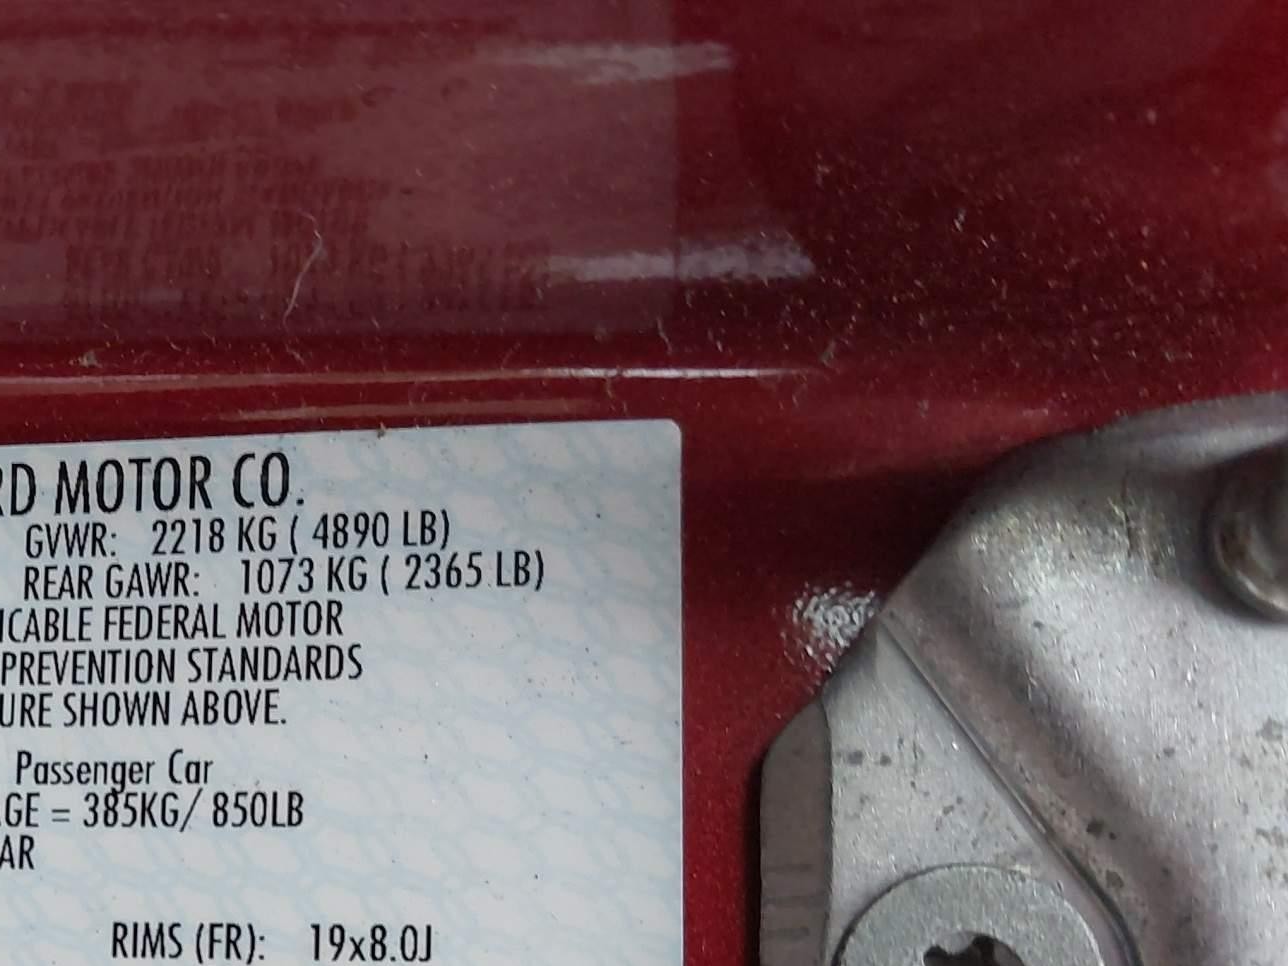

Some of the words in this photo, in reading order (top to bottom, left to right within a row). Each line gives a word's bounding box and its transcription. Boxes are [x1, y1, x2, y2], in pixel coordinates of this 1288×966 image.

[55, 455, 212, 515] MOTOR
[232, 451, 304, 509] CO.
[26, 522, 116, 559] GVWR:
[152, 518, 224, 555] 2218
[238, 516, 276, 552] KG
[312, 512, 389, 549] 4890
[403, 509, 449, 550] LB)
[24, 564, 93, 601] REAR
[106, 561, 199, 599] GAWR:
[241, 557, 314, 595] 1073
[327, 555, 367, 592] KG
[405, 552, 482, 590] 2365
[497, 550, 543, 591] LB)
[104, 603, 226, 641] FEDERAL
[236, 600, 343, 638] MOTOR
[1, 648, 175, 686] PREVENTION
[188, 644, 363, 683] STANDARDS
[64, 691, 170, 727] SHOWN
[181, 688, 286, 726] ABOVE.
[16, 750, 155, 797] Passenger
[169, 749, 213, 784] Car
[52, 809, 70, 822] =
[83, 787, 203, 832] 385KG/
[213, 791, 303, 827] 850LB
[112, 922, 182, 959] RIMS
[196, 923, 264, 965] (FR):
[311, 924, 431, 962] 19x8.0J
